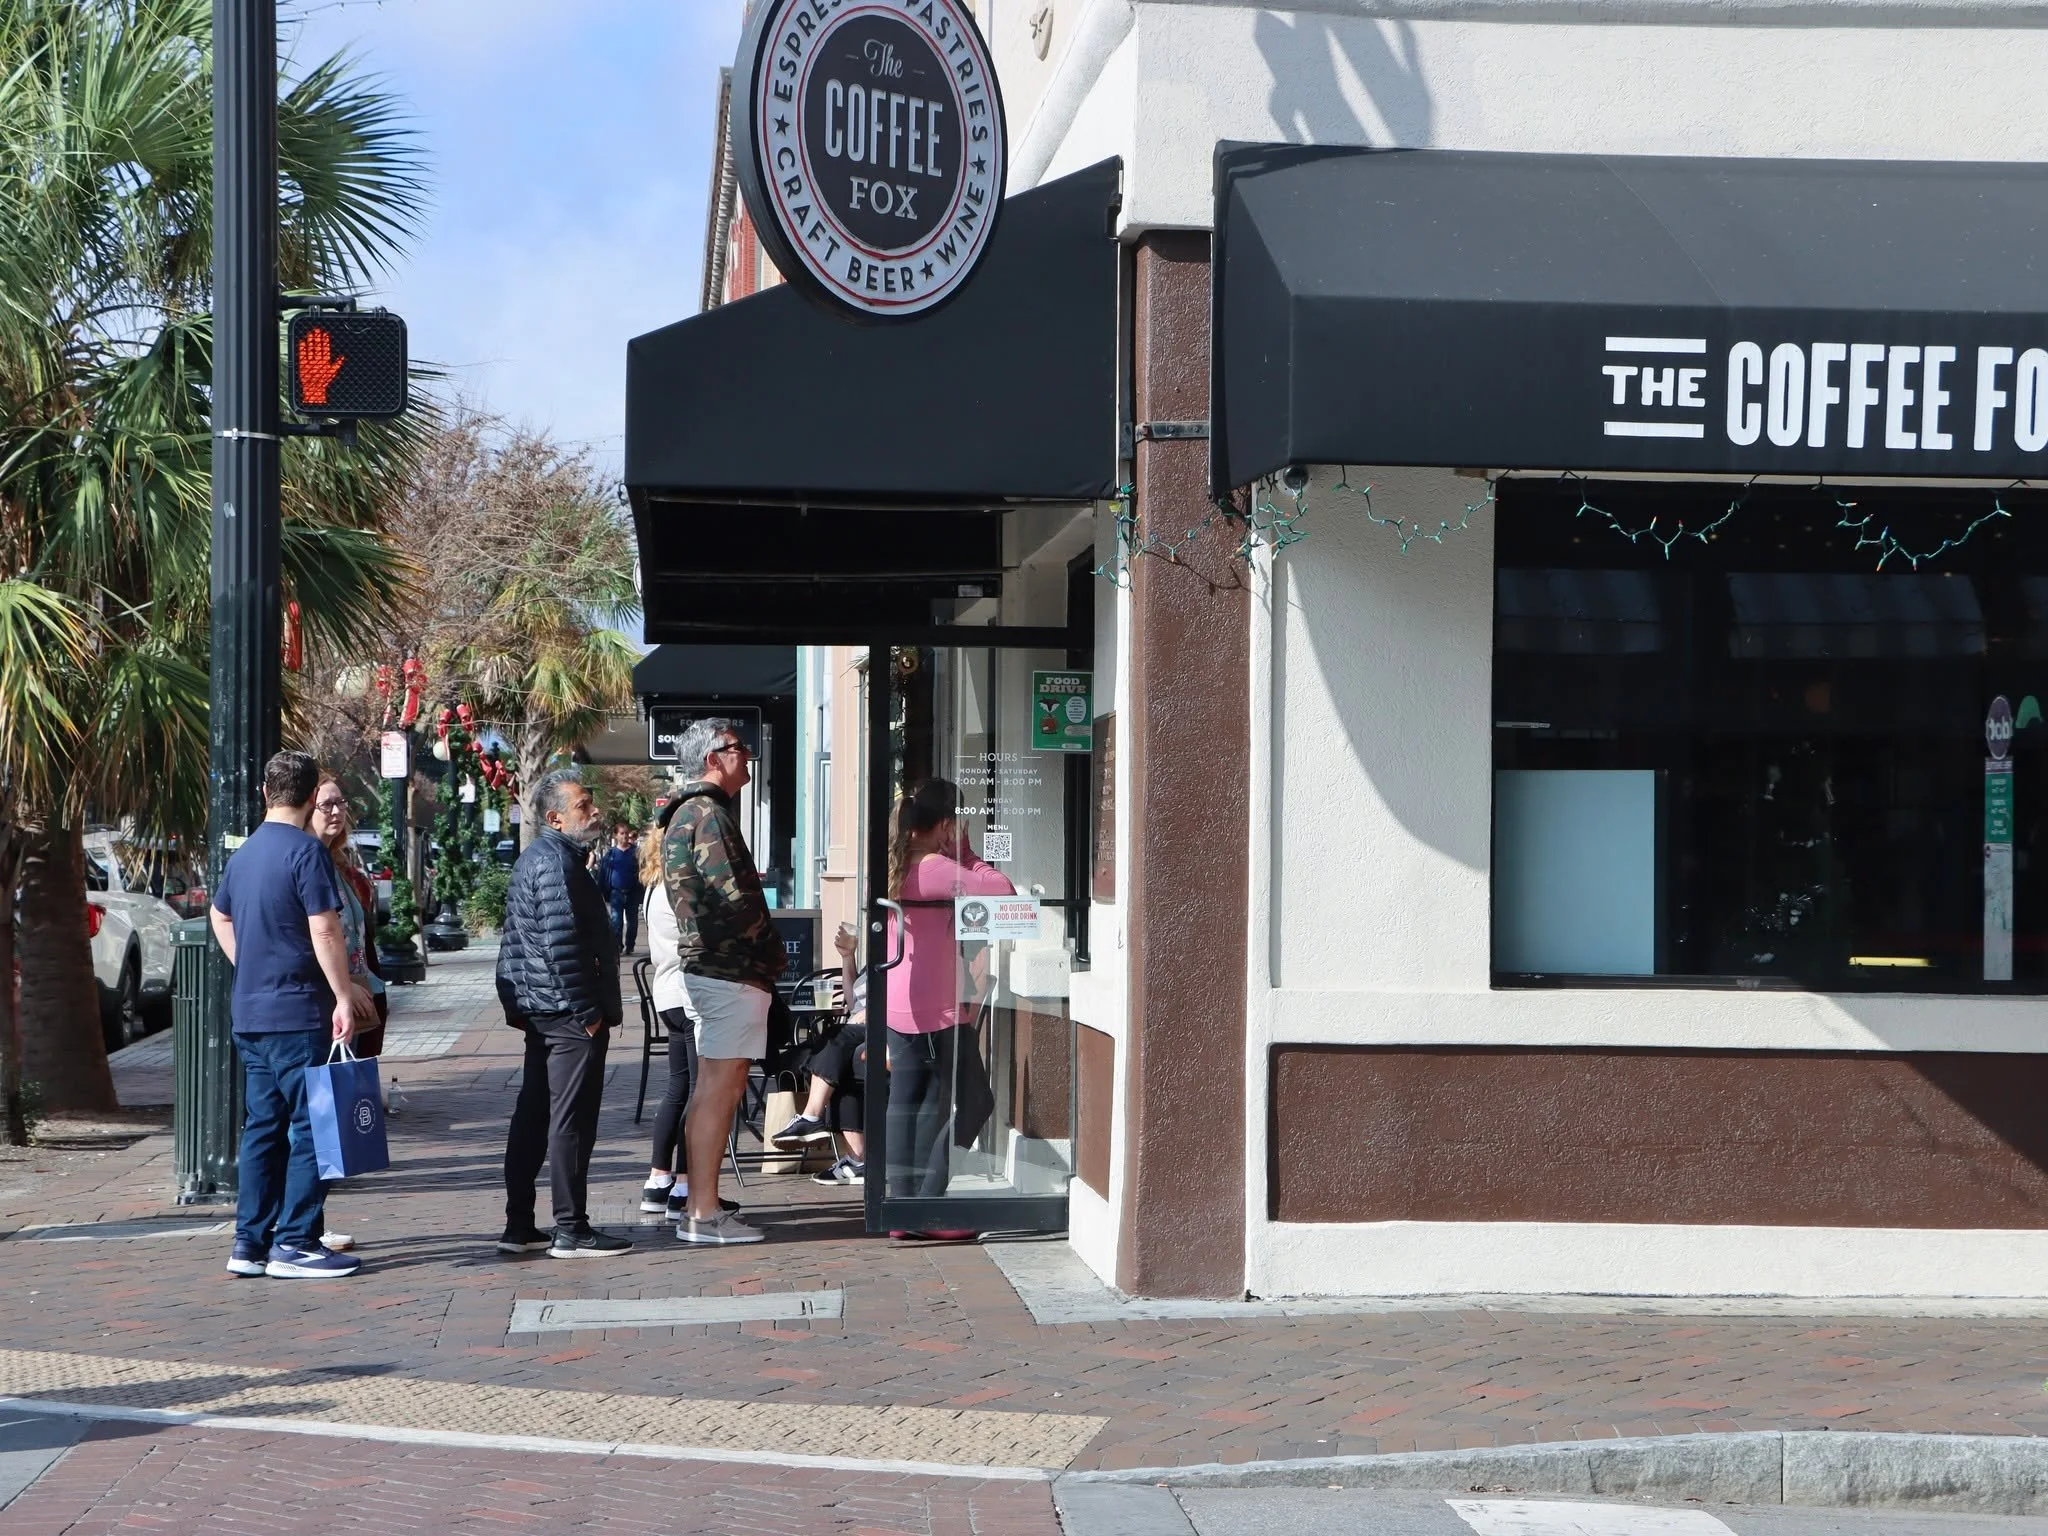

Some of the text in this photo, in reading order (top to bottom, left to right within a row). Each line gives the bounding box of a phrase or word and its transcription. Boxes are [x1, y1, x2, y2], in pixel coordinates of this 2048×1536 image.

[863, 38, 904, 79] The
[824, 78, 943, 178] COFFEE
[849, 175, 918, 221] FOX
[775, 146, 985, 293] CRAFT BEER WINE
[1602, 365, 1707, 408] THE
[1726, 341, 1956, 451] COFFEE
[1045, 677, 1081, 685] FOOD
[1039, 684, 1087, 694] DRIVE
[979, 752, 1018, 762] HOURS
[954, 777, 976, 785] 7:00
[979, 777, 994, 785] AM
[1028, 778, 1042, 786] PM
[954, 806, 976, 815] 8:00
[979, 806, 994, 815] AM
[1027, 807, 1041, 815] PM
[999, 903, 1032, 912] NO OUTSIDE
[994, 911, 1037, 921] FOOD OR DRINK
